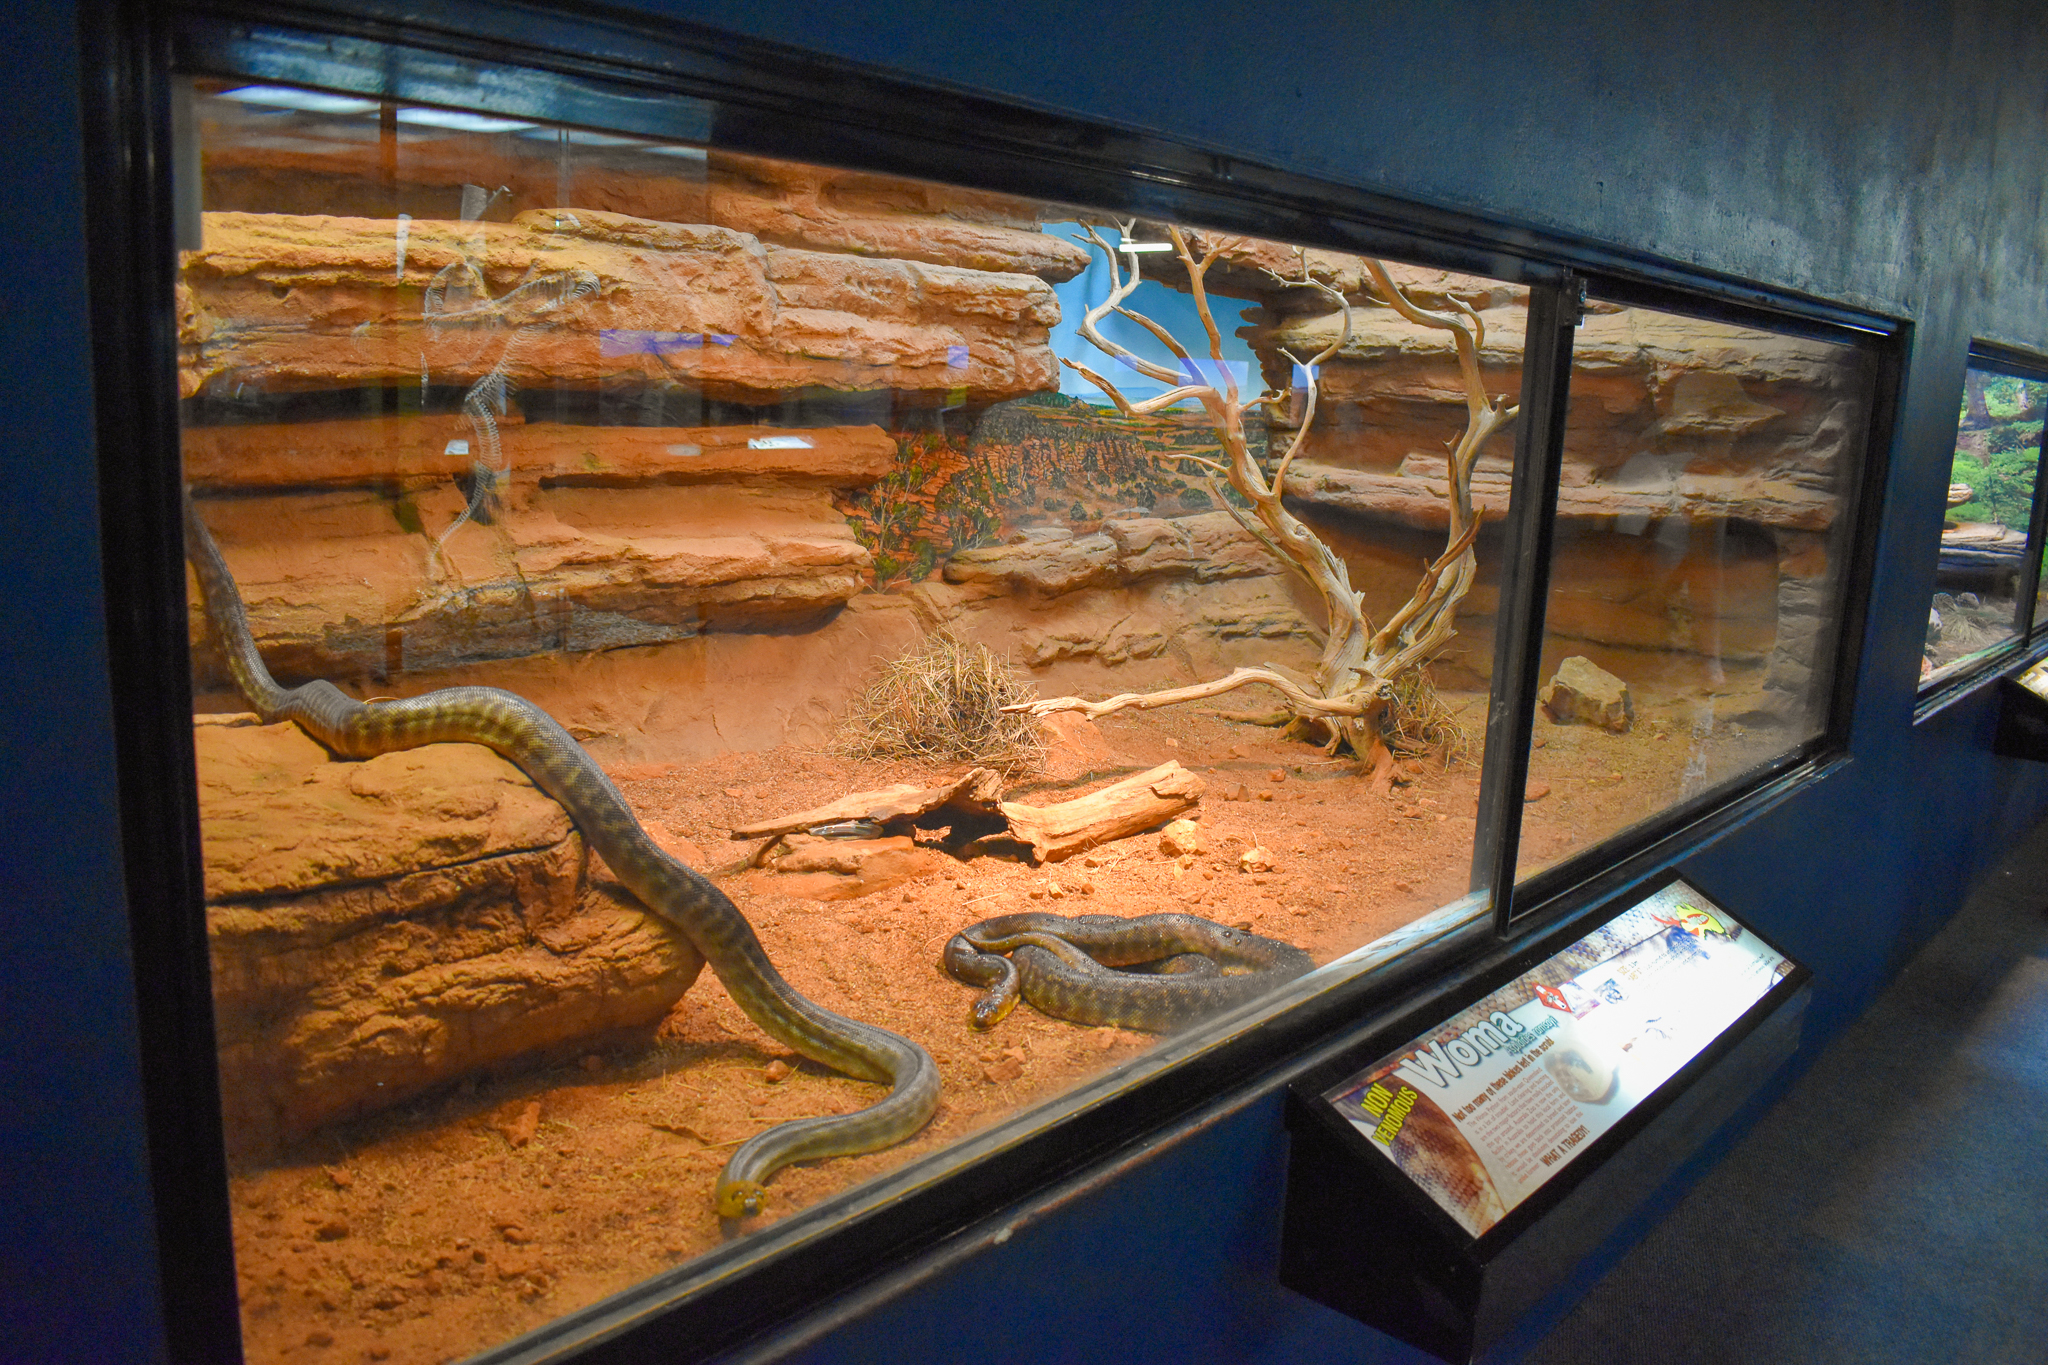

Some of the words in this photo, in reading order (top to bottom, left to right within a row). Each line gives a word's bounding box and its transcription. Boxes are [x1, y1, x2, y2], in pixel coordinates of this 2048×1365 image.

[1400, 1011, 1526, 1088] Woma
[1530, 1048, 1542, 1057] the
[1517, 1057, 1531, 1067] left
[1527, 1053, 1535, 1061] in
[1502, 1065, 1522, 1080] blokes
[1491, 1076, 1508, 1090] these
[1485, 1087, 1496, 1096] of
[1361, 1082, 1394, 1118] NON
[1472, 1092, 1490, 1107] many
[1461, 1102, 1476, 1114] too
[1371, 1086, 1418, 1147] VENOMOUS
[1451, 1109, 1468, 1122] Not
[1561, 1125, 1590, 1150] TRAGEDY!
[1556, 1145, 1567, 1154] A
[1540, 1148, 1562, 1167] WHAT
